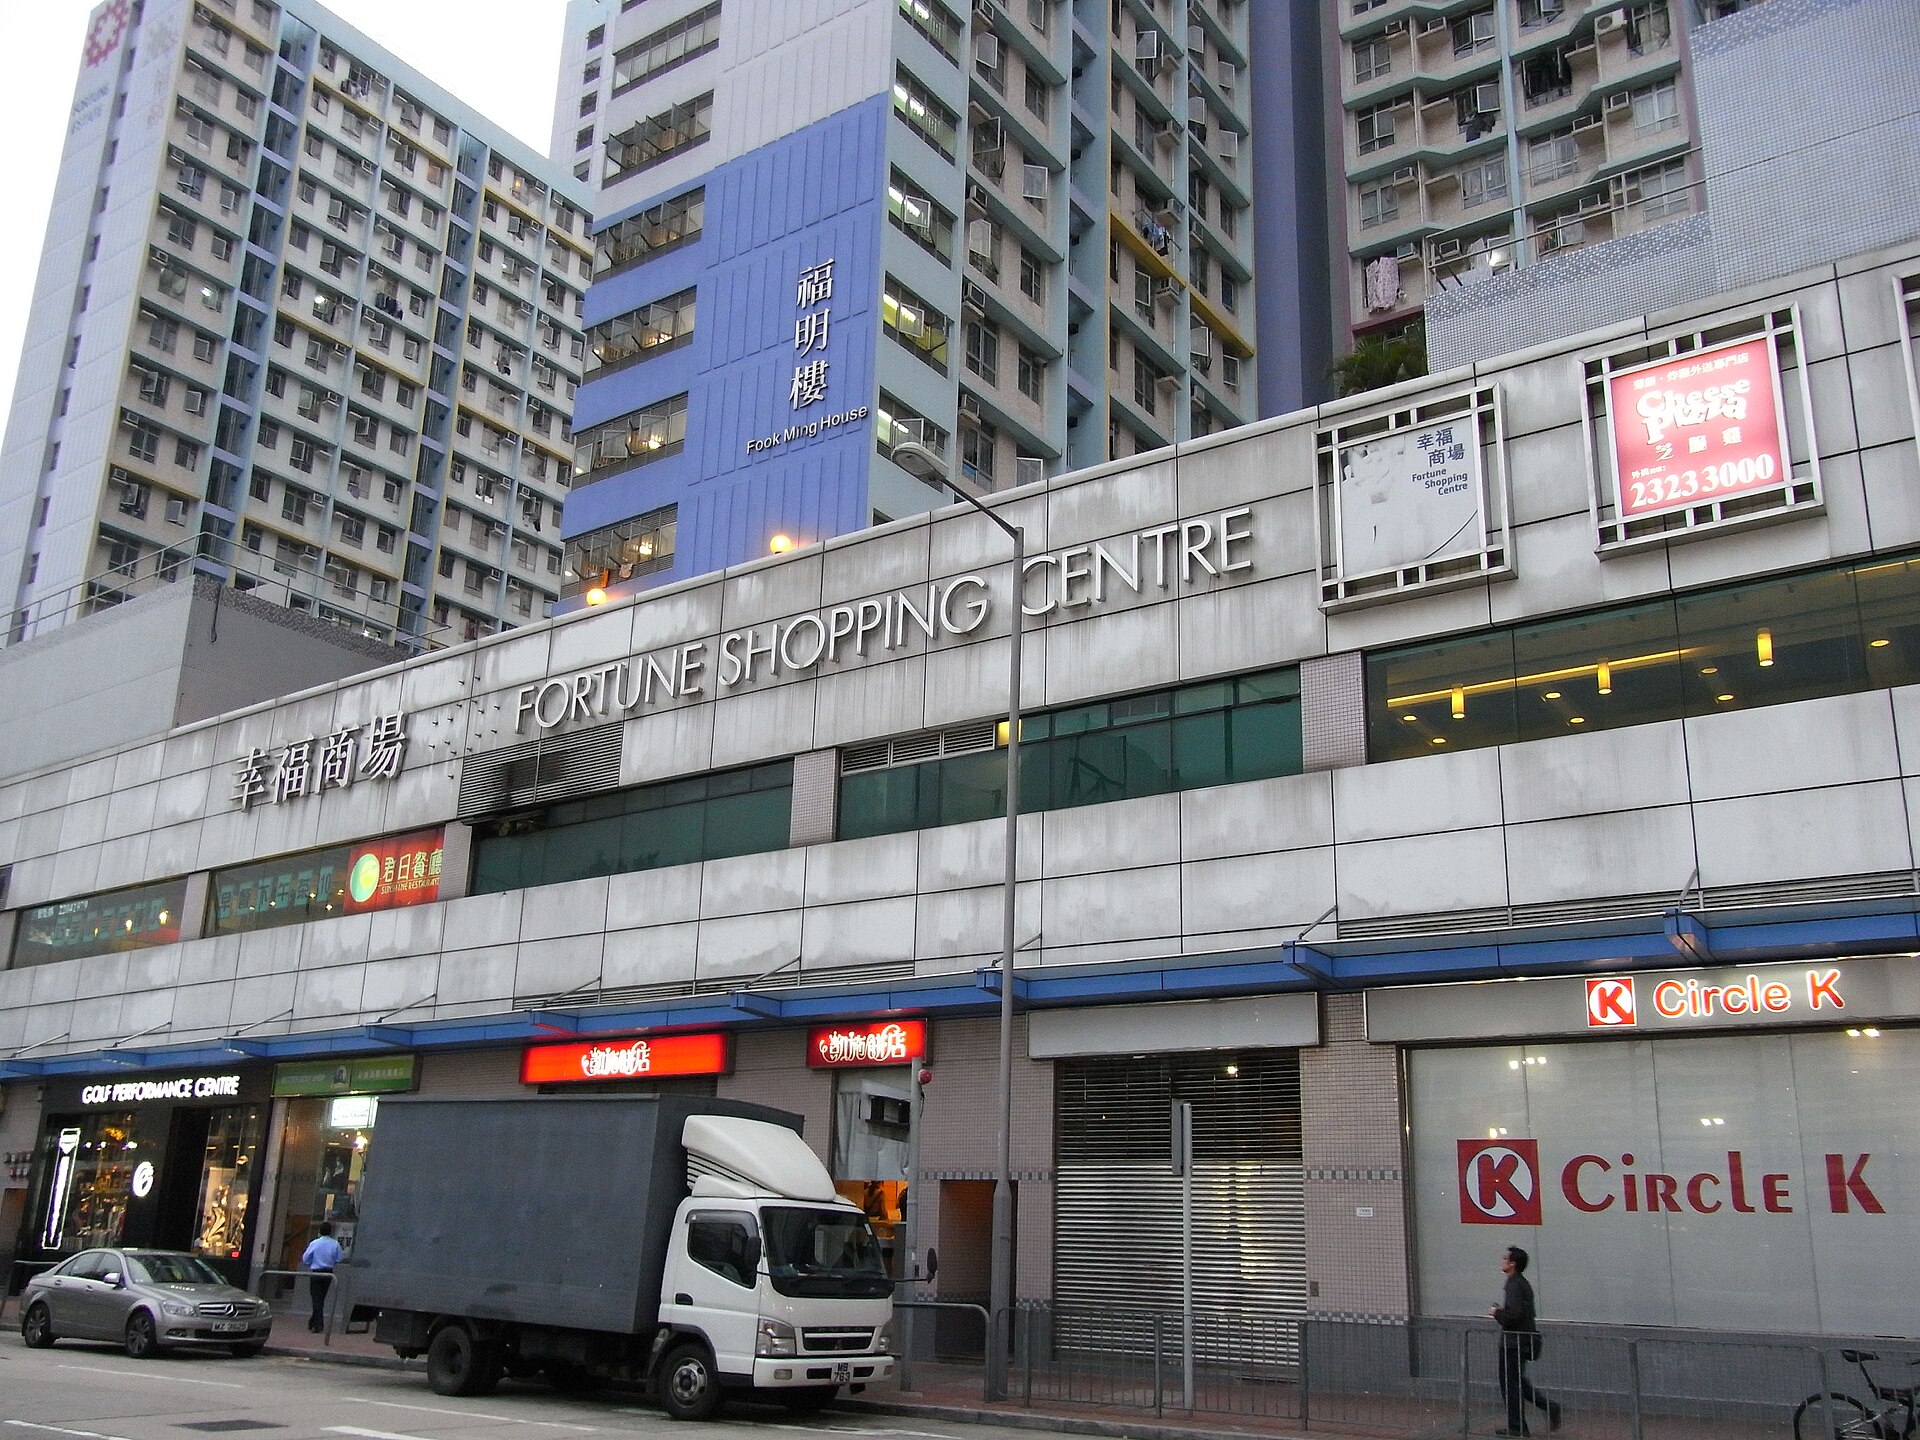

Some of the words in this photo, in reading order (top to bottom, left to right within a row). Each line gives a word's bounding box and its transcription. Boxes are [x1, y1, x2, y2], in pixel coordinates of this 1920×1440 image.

[788, 258, 835, 410] 福明樓
[1636, 378, 1751, 418] Cheese
[746, 434, 780, 454] Fook
[783, 421, 817, 441] Ming
[820, 405, 868, 431] House
[1417, 427, 1453, 451] 幸福
[1642, 396, 1748, 445] Pizza
[1412, 468, 1447, 482] Fortune
[1428, 443, 1465, 467] 商場
[1425, 473, 1468, 489] Shopping
[1438, 483, 1468, 496] Centre
[514, 643, 704, 734] FORTUNE
[717, 575, 989, 687] SHOPPING
[1020, 507, 1254, 616] CENTRE
[230, 710, 406, 811] 幸福商場
[382, 849, 443, 883] 君日餐廳
[1598, 986, 1625, 1019] K
[1653, 974, 1791, 1019] Circle
[1807, 968, 1846, 1011] K
[82, 1084, 112, 1104] GOLF
[112, 1079, 193, 1101] PERFORMANCE
[194, 1076, 240, 1097] CENTRE
[1825, 1153, 1886, 1214] K
